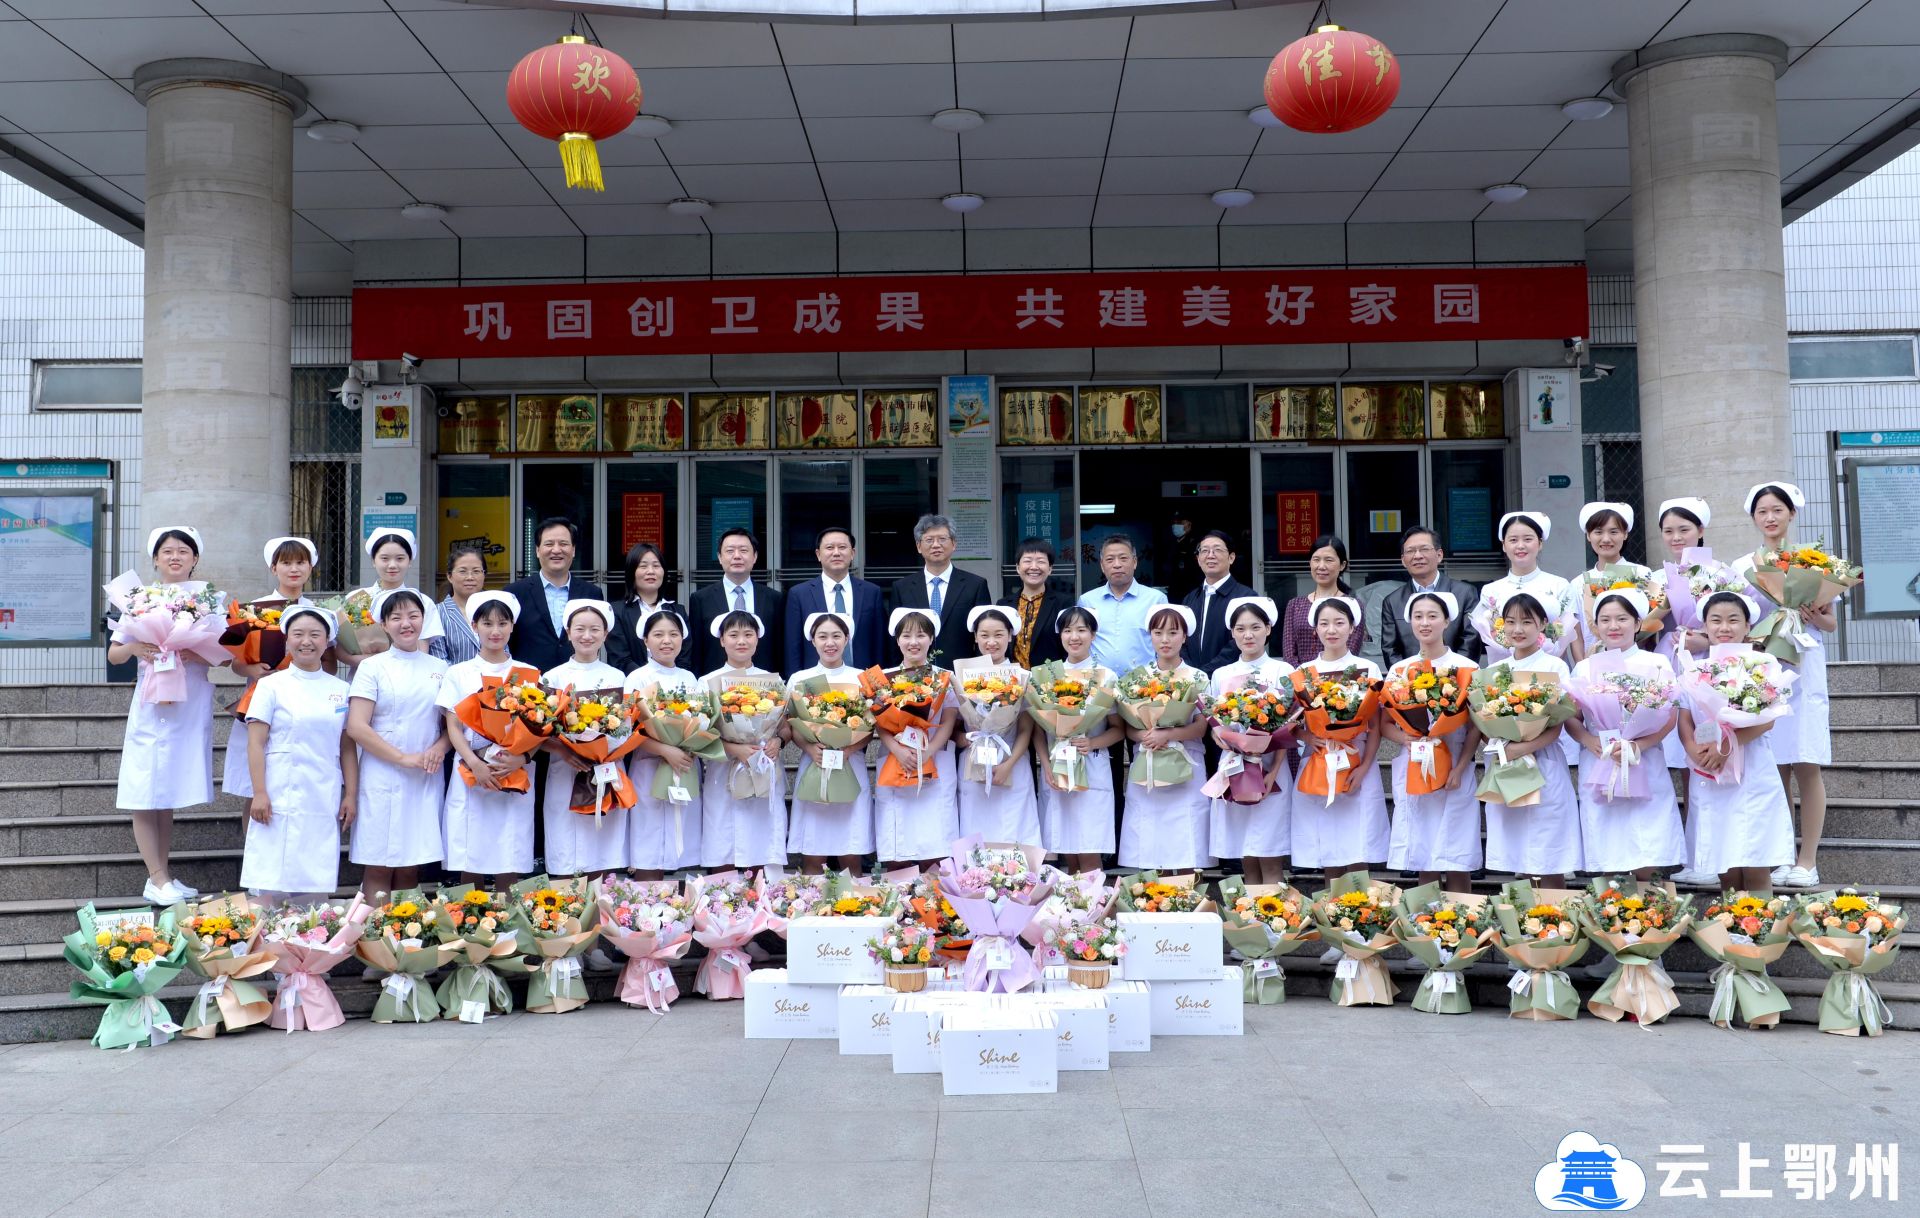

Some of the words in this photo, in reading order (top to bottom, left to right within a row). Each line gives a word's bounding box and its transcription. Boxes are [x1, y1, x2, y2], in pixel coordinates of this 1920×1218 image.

[463, 291, 925, 341] 巩固创卫成果
[1015, 283, 1481, 330] 共建美好家园
[1285, 498, 1297, 547] 谢谢配合
[1300, 498, 1312, 547] 禁止探视
[817, 942, 853, 958] Shine
[1155, 938, 1192, 955] Shine
[774, 998, 810, 1014] Shine
[1175, 994, 1213, 1011] Shine
[871, 1012, 891, 1029] Shi
[979, 1048, 1021, 1066] Shine
